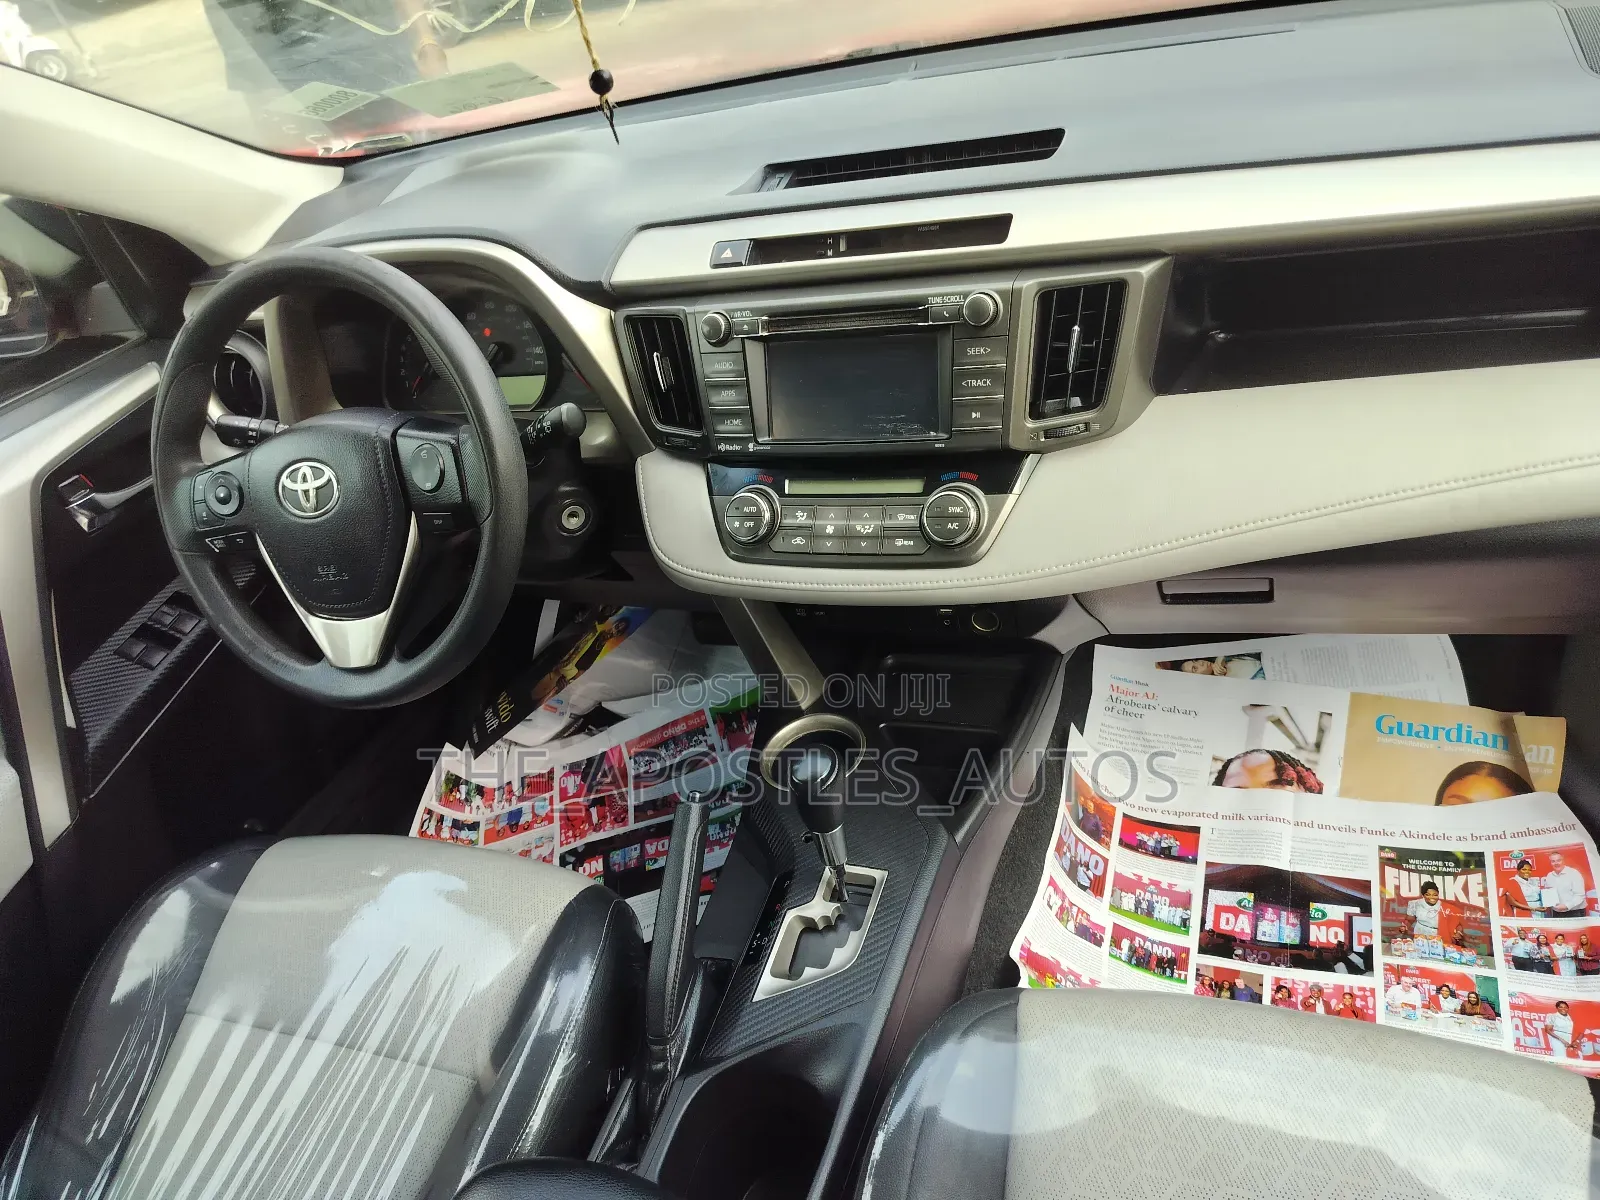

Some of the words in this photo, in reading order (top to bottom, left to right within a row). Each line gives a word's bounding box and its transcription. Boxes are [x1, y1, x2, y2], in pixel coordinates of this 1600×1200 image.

[714, 361, 734, 369] AUDIO
[724, 418, 743, 426] HOME
[947, 506, 964, 514] SYNC
[743, 521, 755, 529] OFF
[947, 522, 959, 530] A/C
[1109, 684, 1140, 698] Major
[1104, 705, 1116, 714] of
[1117, 708, 1145, 719] cheer
[1161, 703, 1200, 718] calvary
[662, 723, 688, 738] DANO
[1375, 713, 1509, 751] Guardian
[1118, 797, 1136, 810] two
[1137, 804, 1160, 814] new
[1160, 807, 1219, 821] evaporated
[1220, 810, 1245, 821] milk
[1248, 812, 1291, 825] variants
[1293, 817, 1314, 828] and
[1317, 822, 1356, 834] unveils
[1359, 826, 1396, 838] Funke
[1399, 829, 1453, 841] Akindele
[1455, 833, 1468, 842] as
[1470, 830, 1507, 841] brand
[1509, 821, 1577, 839] ambassador
[1408, 858, 1442, 867] WELCOME
[1438, 866, 1462, 874] FAMILY
[1384, 865, 1485, 908] FUNKE
